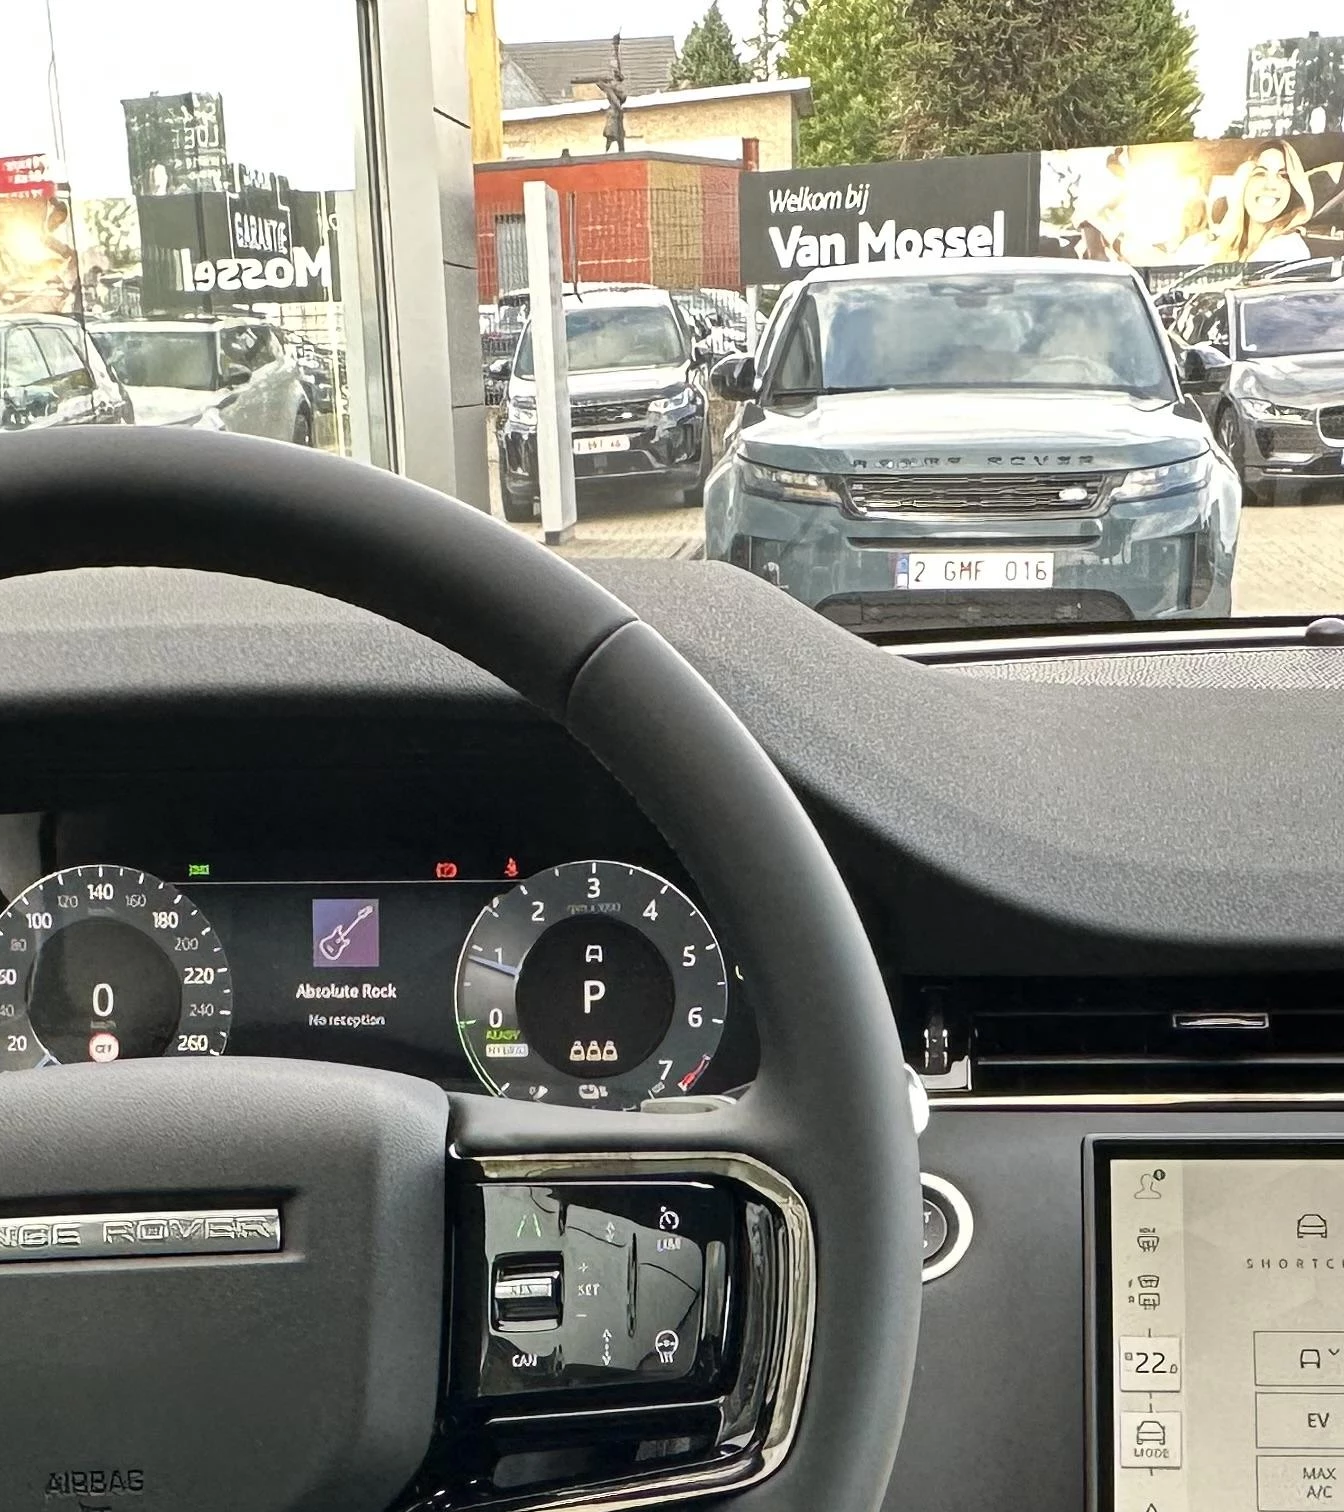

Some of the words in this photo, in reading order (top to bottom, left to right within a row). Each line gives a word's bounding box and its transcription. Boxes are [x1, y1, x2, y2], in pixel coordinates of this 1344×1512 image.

[769, 186, 842, 213] Welkom
[845, 183, 871, 216] bij
[768, 224, 846, 269] Van
[858, 210, 1005, 263] Mossel
[914, 561, 927, 583] 2
[944, 560, 985, 582] GMF
[1005, 561, 1048, 582] 016
[87, 884, 114, 900] 140
[587, 877, 601, 898] 3
[152, 911, 179, 929] 180
[531, 901, 545, 922] 2
[642, 899, 659, 921] 4
[26, 912, 53, 929] 100
[174, 937, 199, 951] 200
[494, 947, 503, 964] 1
[682, 945, 696, 967] 5
[184, 968, 215, 985] 220
[92, 983, 114, 1017] 0
[296, 983, 359, 999] Absolute
[362, 983, 397, 999] Rock
[583, 980, 606, 1014] P
[189, 1003, 214, 1017] 240
[489, 1008, 503, 1028] 0
[687, 1007, 703, 1028] 6
[7, 1035, 28, 1051] 20
[178, 1035, 208, 1051] 260
[658, 1059, 673, 1081] 7
[103, 1216, 271, 1245] ROVER
[1307, 1412, 1331, 1428] EV
[45, 1469, 145, 1494] AIRBAG
[1302, 1467, 1338, 1480] MAX
[1306, 1485, 1334, 1499] A/C
